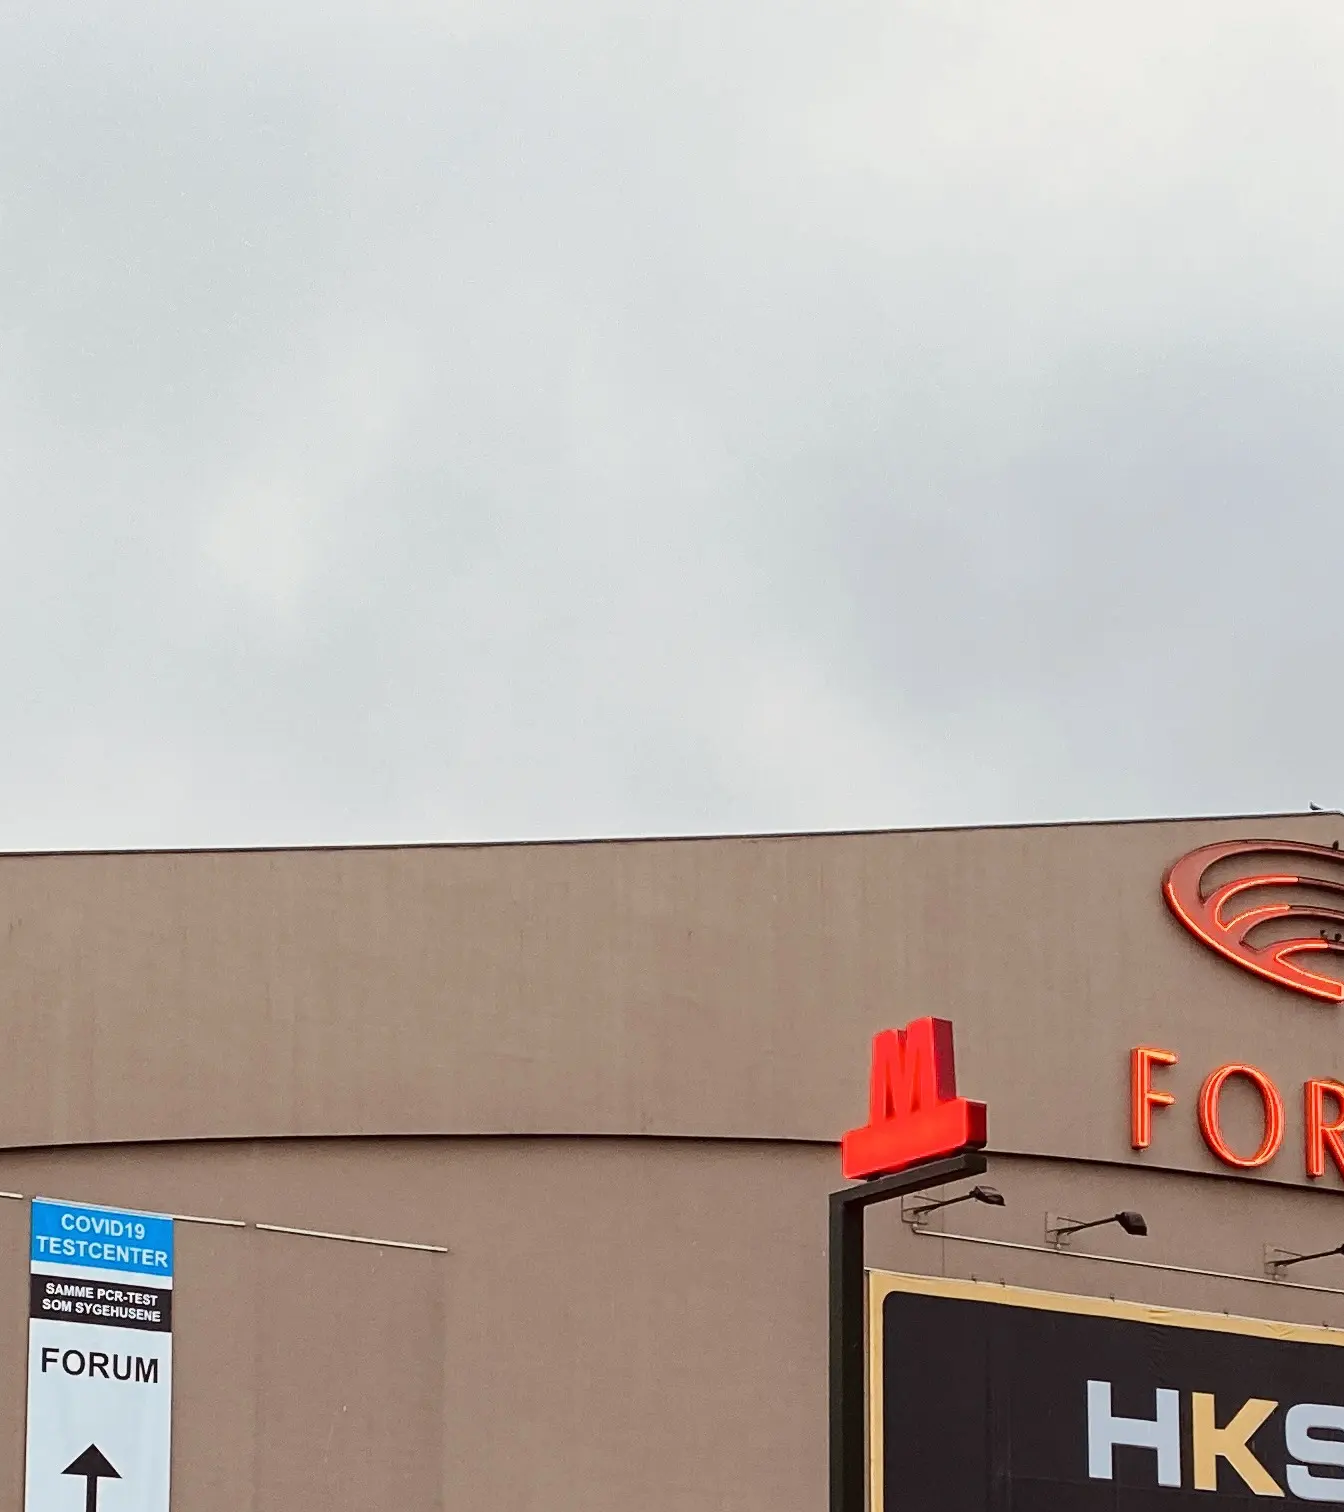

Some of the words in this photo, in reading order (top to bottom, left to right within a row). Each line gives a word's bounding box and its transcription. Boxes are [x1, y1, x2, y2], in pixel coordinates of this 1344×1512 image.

[61, 1213, 145, 1240] COVID19
[36, 1235, 168, 1268] TESTCENTER
[46, 1282, 94, 1299] SAMME
[97, 1288, 158, 1306] PCR-TEST
[42, 1298, 72, 1313] SOM
[75, 1302, 161, 1322] SYGEHUSENE
[41, 1347, 158, 1384] FORUM
